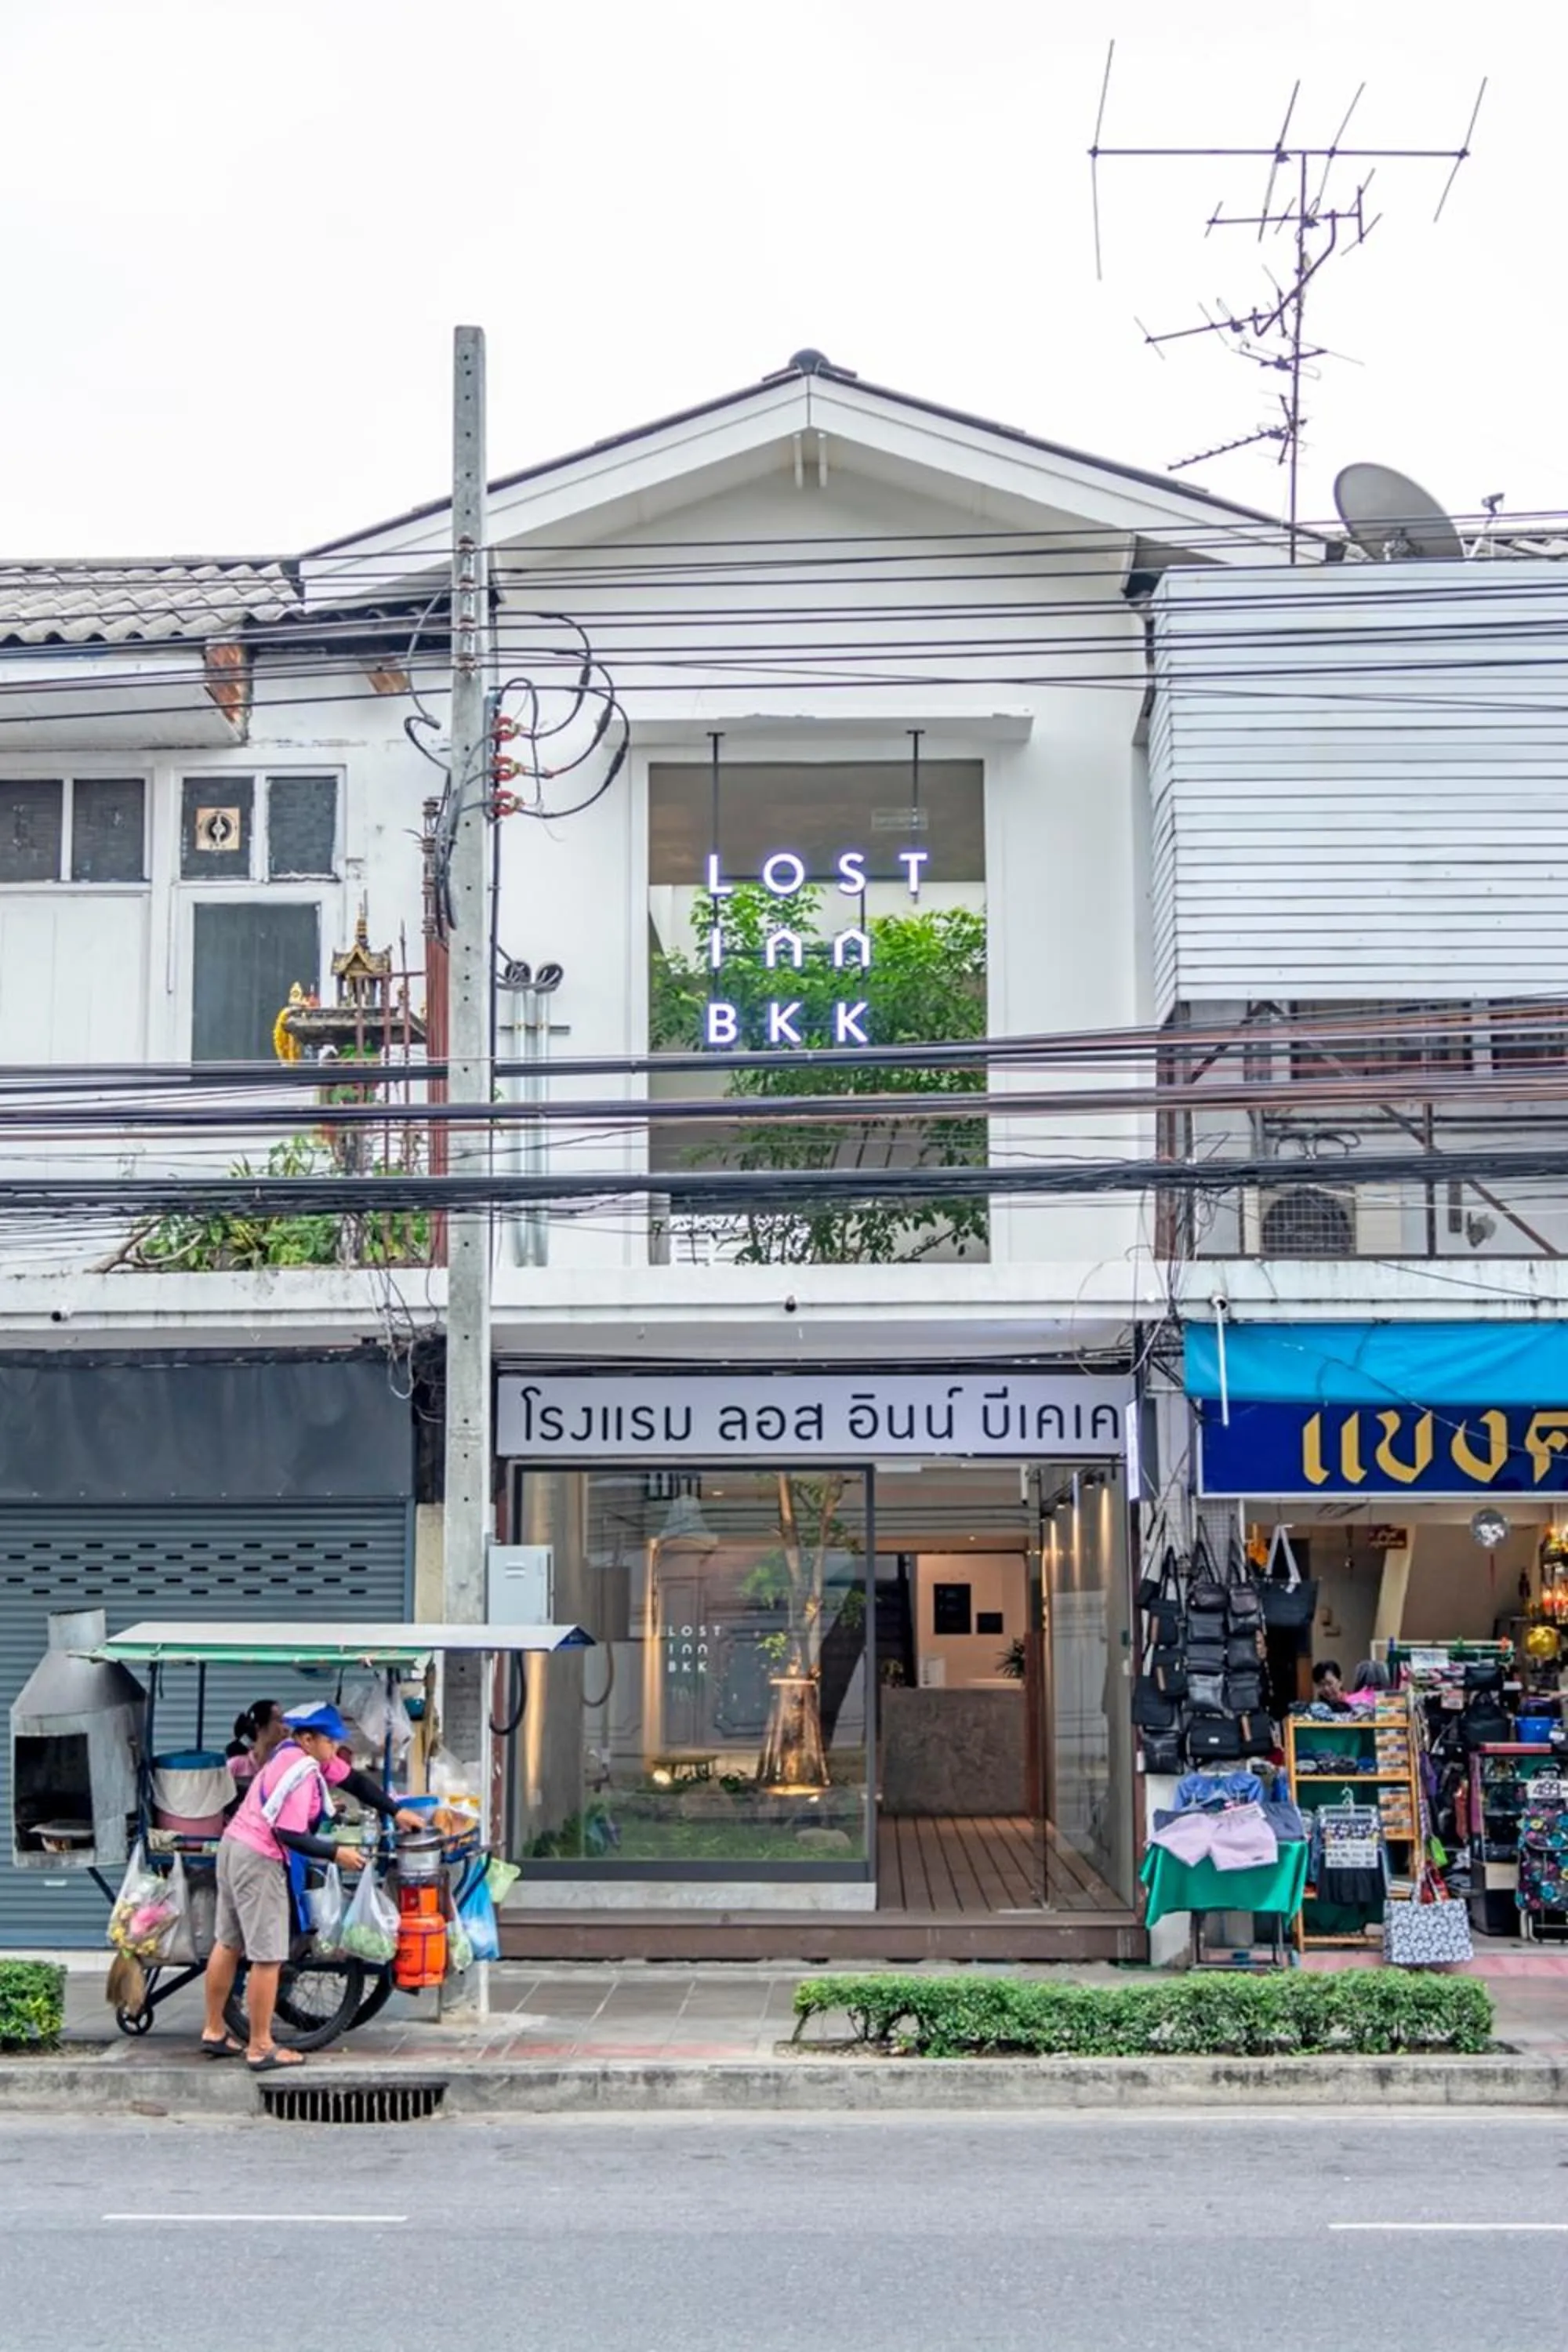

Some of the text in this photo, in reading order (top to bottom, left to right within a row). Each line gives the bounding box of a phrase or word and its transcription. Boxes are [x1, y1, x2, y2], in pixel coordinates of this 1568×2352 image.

[708, 853, 927, 895] LOST
[708, 1002, 868, 1044] BKK
[521, 1385, 1120, 1441] โรงแรม ลอส อินน์ บีเคเค
[668, 1624, 721, 1637] LOST
[668, 1661, 707, 1673] BKK
